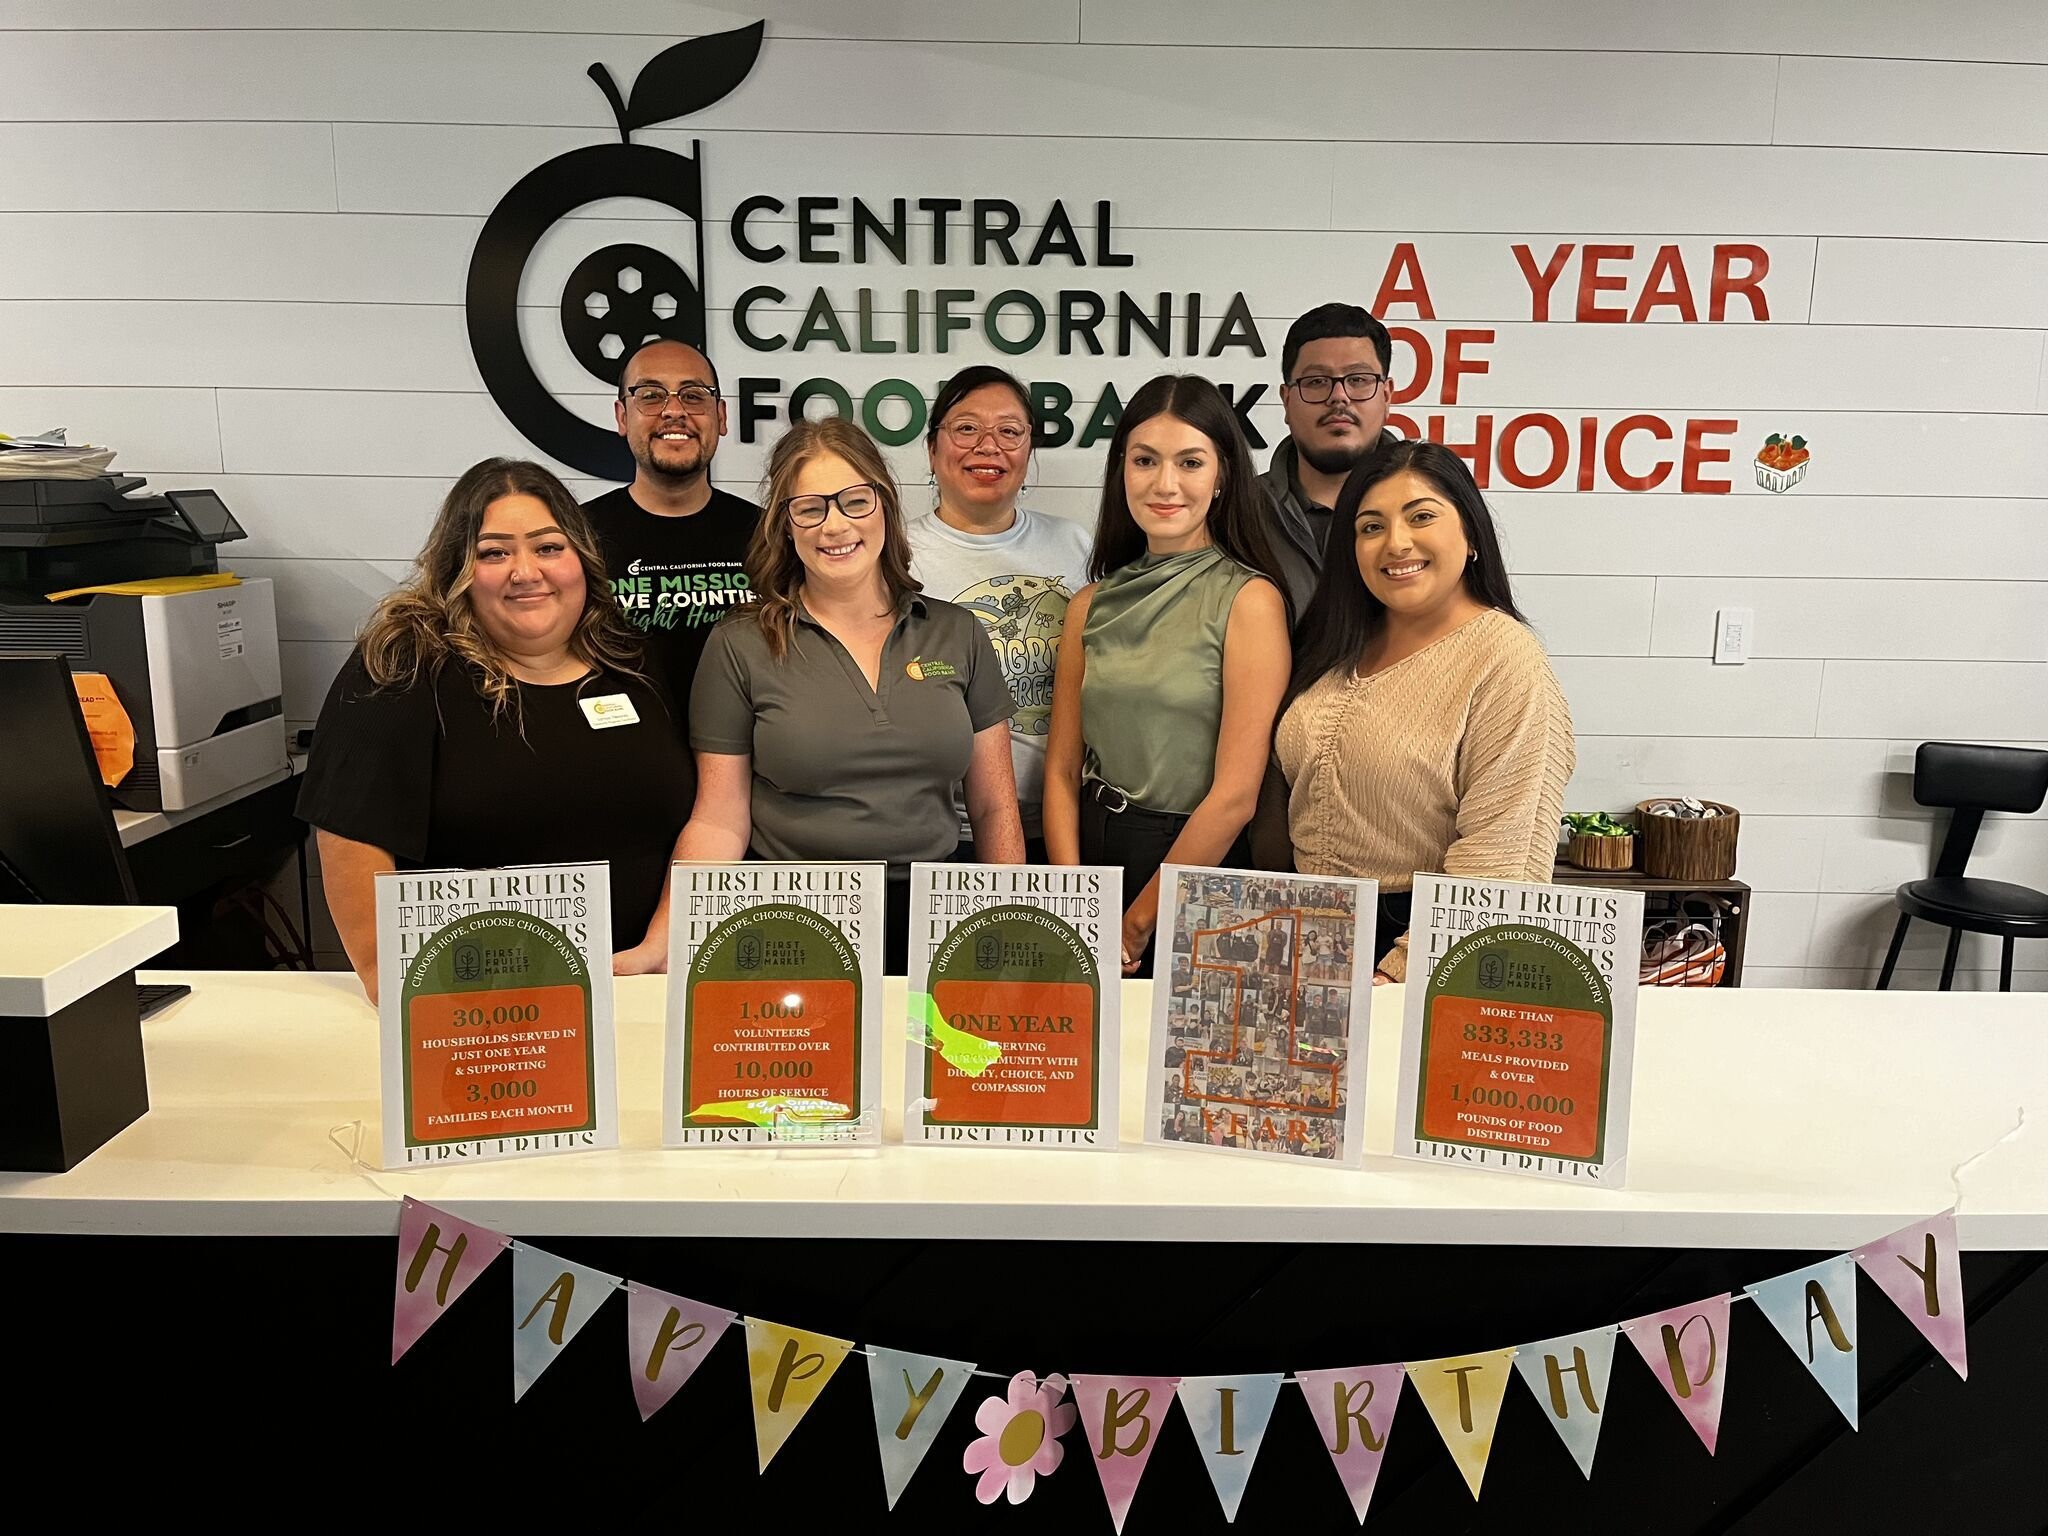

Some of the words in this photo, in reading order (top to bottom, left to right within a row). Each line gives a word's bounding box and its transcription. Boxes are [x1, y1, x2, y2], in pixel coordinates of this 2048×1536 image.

[730, 195, 1134, 267] CENTRAL
[1370, 242, 1436, 321] A
[1510, 244, 1770, 322] YEAR
[732, 285, 1267, 358] CALIFORNIA
[1391, 327, 1495, 405] OF
[739, 377, 949, 447] FOO
[1031, 382, 1269, 450] BAK
[660, 573, 750, 592] MISSIO
[614, 594, 650, 608] IVE
[657, 590, 762, 608] COUNTIE
[400, 878, 478, 902] FIRST
[489, 873, 586, 897] FRUITS
[692, 872, 763, 891] FIRST
[774, 872, 861, 891] FRUITS
[931, 871, 1001, 891] FIRST
[1012, 873, 1099, 893] FRUITS
[689, 895, 763, 915] FIRST
[929, 895, 1001, 915] FIRST
[1434, 884, 1510, 909] FIRST
[1520, 891, 1617, 919] FRUITS
[399, 903, 479, 928] FIRST
[1430, 907, 1509, 931] FIRST
[412, 946, 439, 987] CHOOSE
[439, 927, 469, 949] HOPE,
[470, 918, 515, 931] CHOOSE
[517, 921, 554, 944] CHOICE
[554, 940, 582, 977] PANTRY
[486, 948, 521, 957] FIRST
[698, 935, 725, 974] CHOOSE
[724, 917, 752, 937] HOPE,
[753, 911, 794, 922] CHOOSE
[796, 914, 831, 939] CHOICE
[831, 936, 854, 972] PANTRY
[938, 934, 964, 973] CHOOSE
[964, 918, 991, 937] HOPE,
[992, 912, 1033, 922] CHOOSE
[1034, 915, 1069, 940] CHOICE
[1067, 938, 1092, 976] PANTRY
[1004, 942, 1038, 950] FIRST
[486, 956, 528, 966] FRUITS
[764, 957, 806, 965] MARKET
[1003, 959, 1043, 968] MARKET
[1004, 951, 1043, 959] FRUITS
[485, 965, 529, 975] MARKET
[1437, 949, 1466, 987] CHOOSE
[1466, 935, 1496, 953] HOPE,
[1497, 931, 1541, 943] CHOOSE
[1543, 938, 1580, 967] CHOICE
[1578, 964, 1605, 1005] PANTRY
[1509, 962, 1546, 972] FIRST
[1509, 971, 1552, 981] FRUITS
[1507, 980, 1552, 991] MARKET
[453, 1004, 539, 1028] 30,000
[740, 1001, 804, 1022] 1,000
[1480, 1006, 1516, 1020] MORE
[1519, 1011, 1553, 1024] THAN
[734, 1028, 810, 1038] VOLUNTEERS
[950, 1014, 1000, 1032] ONE
[1008, 1015, 1074, 1034] YEAR
[423, 1033, 509, 1049] HOUSEHOLDS
[511, 1030, 561, 1042] SERVED
[563, 1028, 576, 1038] IN
[713, 1042, 796, 1052] CONTRIBUTED
[798, 1042, 830, 1051] OVER
[998, 1042, 1046, 1051] SERVING
[1463, 1023, 1564, 1052] 833,333
[451, 1050, 482, 1061] JUST
[485, 1047, 511, 1058] ONE
[514, 1045, 546, 1056] YEAR
[973, 1056, 1044, 1065] COMUNITY
[1047, 1057, 1078, 1066] WITH
[1461, 1050, 1502, 1064] MEALS
[1505, 1055, 1569, 1072] PROVIDED
[455, 1066, 464, 1076] &
[467, 1060, 546, 1075] SUPPORTING
[734, 1060, 813, 1080] 10,000
[1001, 1070, 1046, 1080] CHOICE,
[1049, 1071, 1074, 1080] AND
[1489, 1070, 1498, 1079] &
[1501, 1071, 1535, 1084] OVER
[467, 1079, 537, 1105] 3,000
[718, 1088, 759, 1098] HOURS
[762, 1088, 778, 1097] OF
[780, 1088, 829, 1096] SERVICE
[972, 1083, 1046, 1093] COMPASSION
[1451, 1083, 1574, 1116] 1,000,000
[428, 1111, 488, 1125] FAMILIES
[491, 1108, 524, 1120] EACH
[528, 1104, 573, 1116] MONTH
[1456, 1112, 1506, 1127] POUNDS
[1509, 1117, 1525, 1129] OF
[1528, 1120, 1563, 1135] FOOD
[1202, 1108, 1312, 1144] YEAR
[1467, 1127, 1549, 1147] DISTRIBUTED
[405, 1222, 945, 1441] HAPPY
[1096, 1232, 1941, 1461] BIRTHDAY
